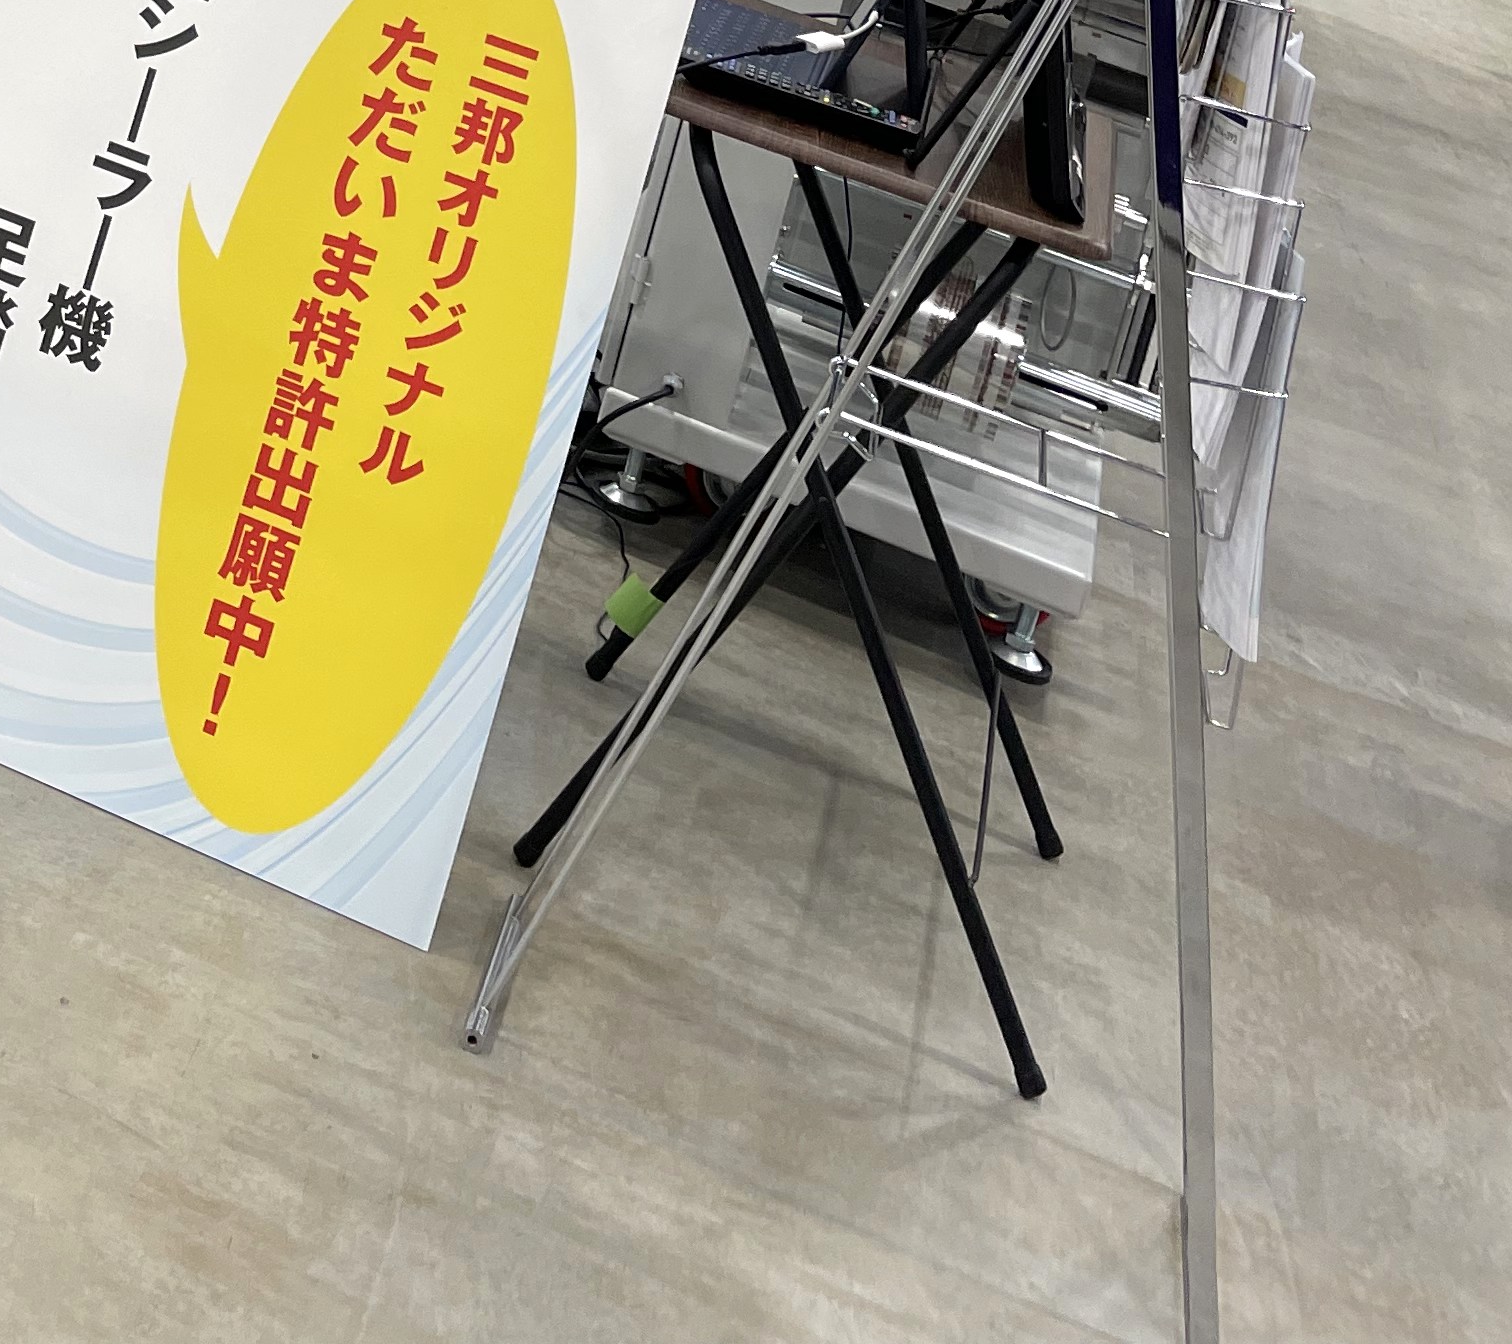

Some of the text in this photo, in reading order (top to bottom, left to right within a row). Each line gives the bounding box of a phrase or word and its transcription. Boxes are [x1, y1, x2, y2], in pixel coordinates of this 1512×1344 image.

[198, 15, 443, 738] ただいま特許出願中!
[359, 32, 540, 486] 三邦オリジナル
